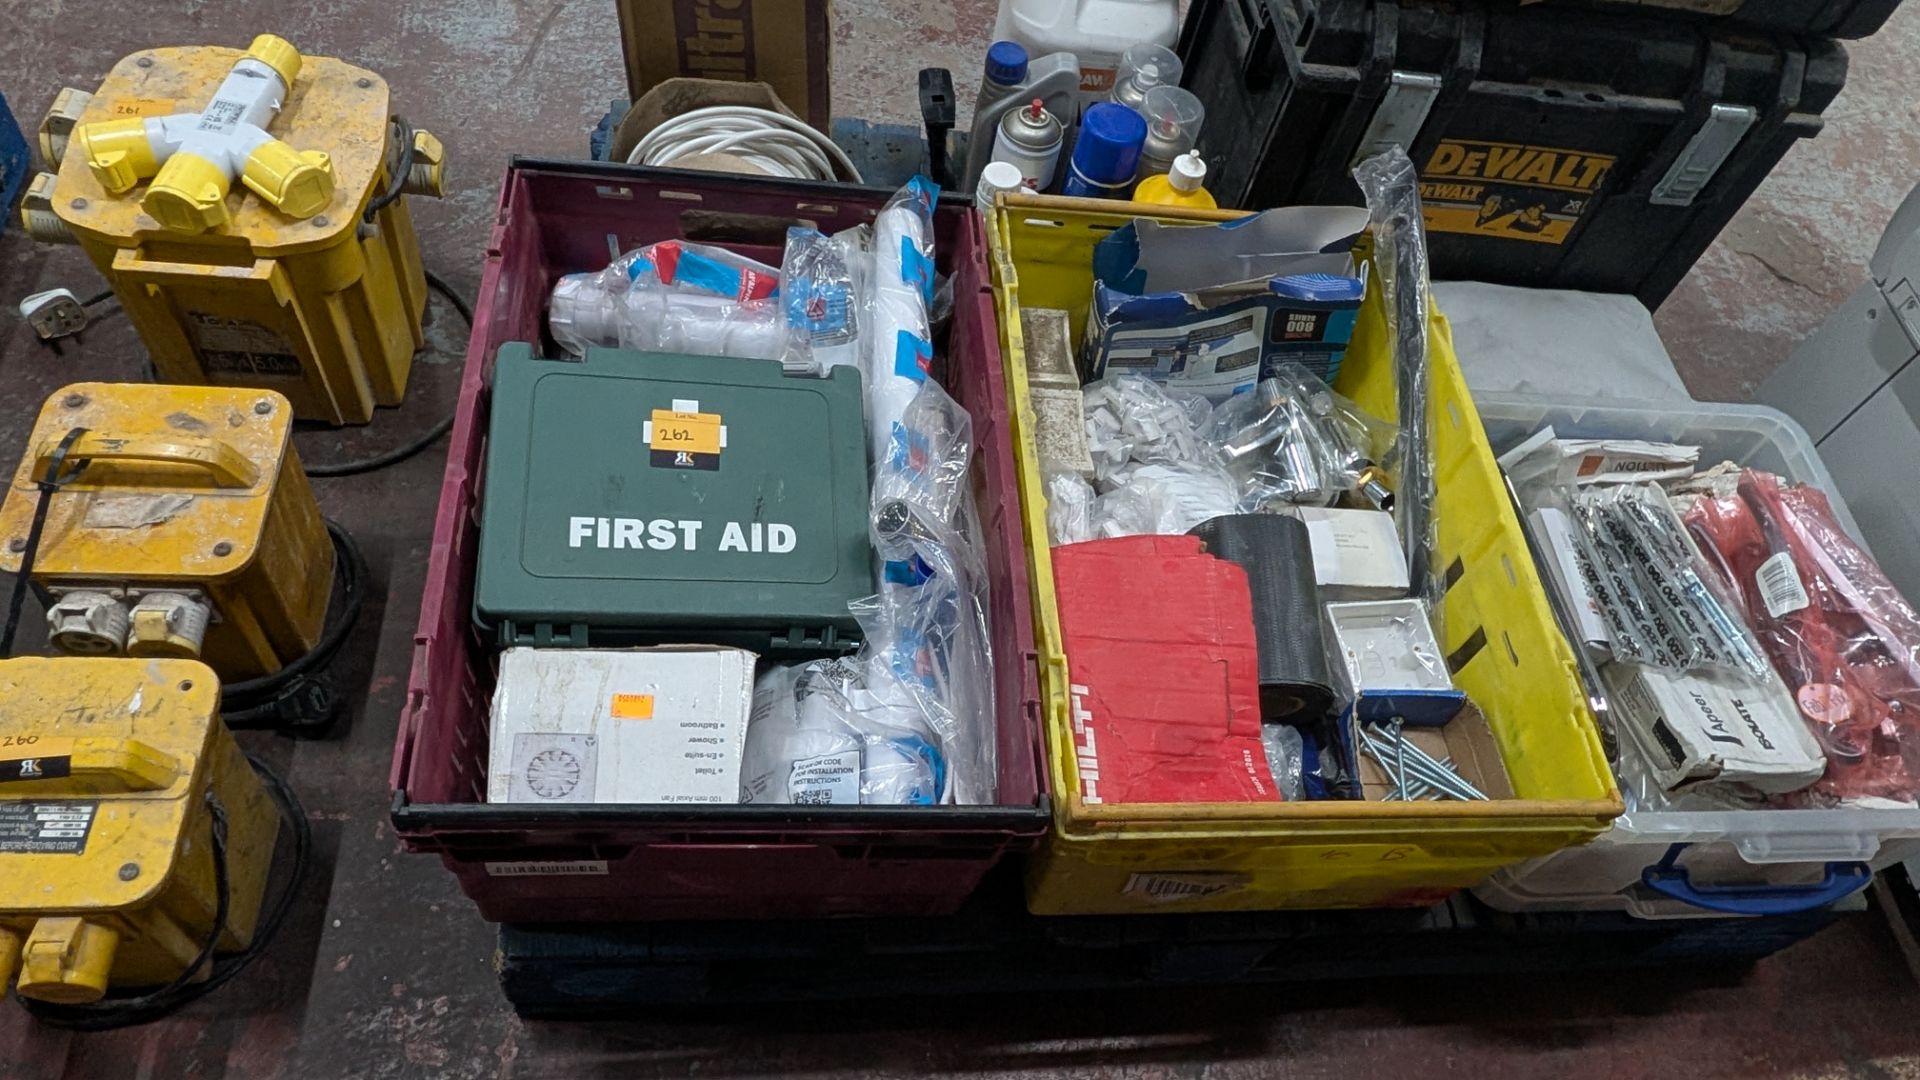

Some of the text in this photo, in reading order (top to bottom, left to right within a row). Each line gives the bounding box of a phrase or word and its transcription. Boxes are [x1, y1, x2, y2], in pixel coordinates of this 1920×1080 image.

[117, 105, 140, 115] 261
[1286, 321, 1315, 333] 800
[659, 428, 695, 441] 262
[569, 516, 798, 554] FIRST AID
[1689, 690, 1729, 734] Apeer
[680, 721, 719, 730] Bathroom
[1730, 698, 1776, 750] ISOLATE
[3, 735, 39, 747] 260
[688, 737, 718, 745] Shower
[1070, 683, 1103, 804] HILTI
[684, 752, 717, 760] En-suite
[823, 758, 842, 766] CODE
[695, 767, 716, 775] Toilet
[807, 767, 854, 775] INSTALLATION
[793, 777, 842, 786] INSTRUCTIONS
